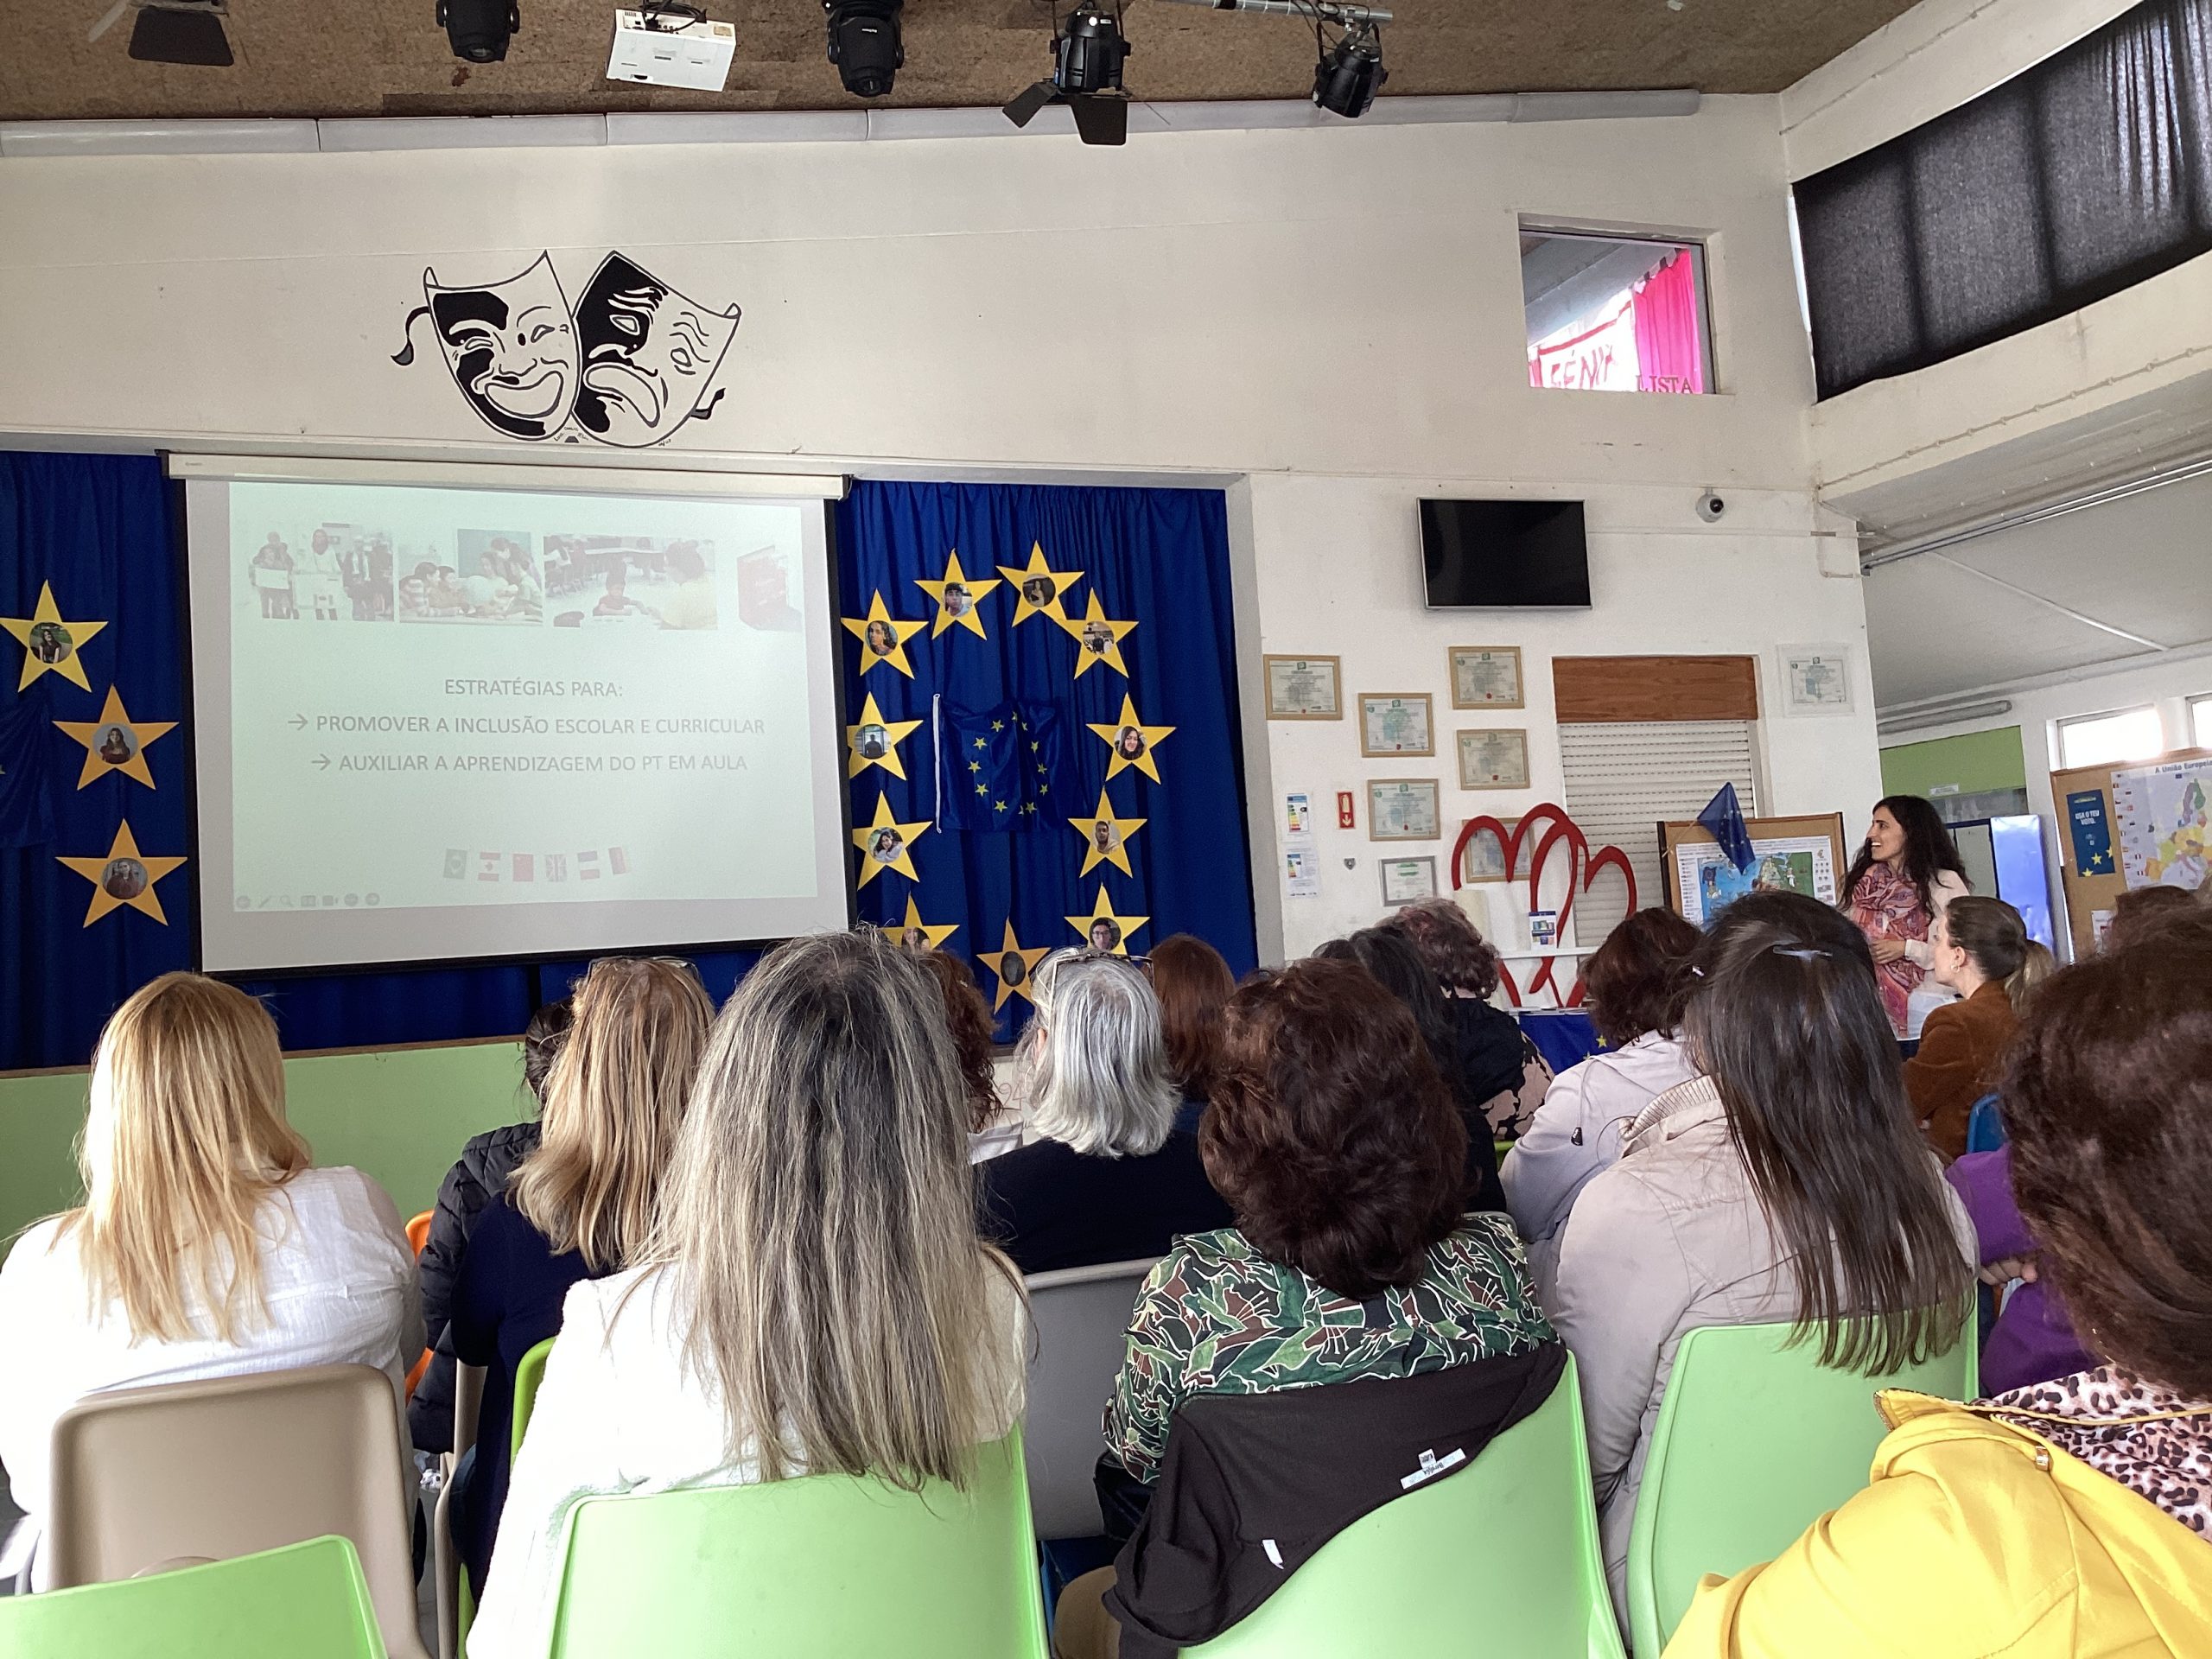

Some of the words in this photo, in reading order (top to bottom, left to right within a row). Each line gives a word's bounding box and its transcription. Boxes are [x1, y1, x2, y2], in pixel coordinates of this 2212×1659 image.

[1635, 374, 1694, 394] LISTA
[444, 677, 565, 696] ESTRATÉGIAS
[571, 681, 623, 697] PARA:
[316, 715, 430, 732] PROMOVER
[435, 717, 449, 733] A
[454, 715, 549, 734] INCLUSÃO
[555, 719, 635, 734] ESCOLAR
[640, 719, 651, 734] E
[655, 718, 766, 734] CURRICULAR
[338, 755, 429, 772] AUXILIAR
[435, 755, 448, 772] A
[453, 755, 603, 772] APRENDIZAGEM
[609, 756, 636, 772] DO
[643, 755, 663, 771] PT
[669, 755, 696, 771] EM
[701, 755, 747, 771] AULA
[2161, 764, 2183, 773] União
